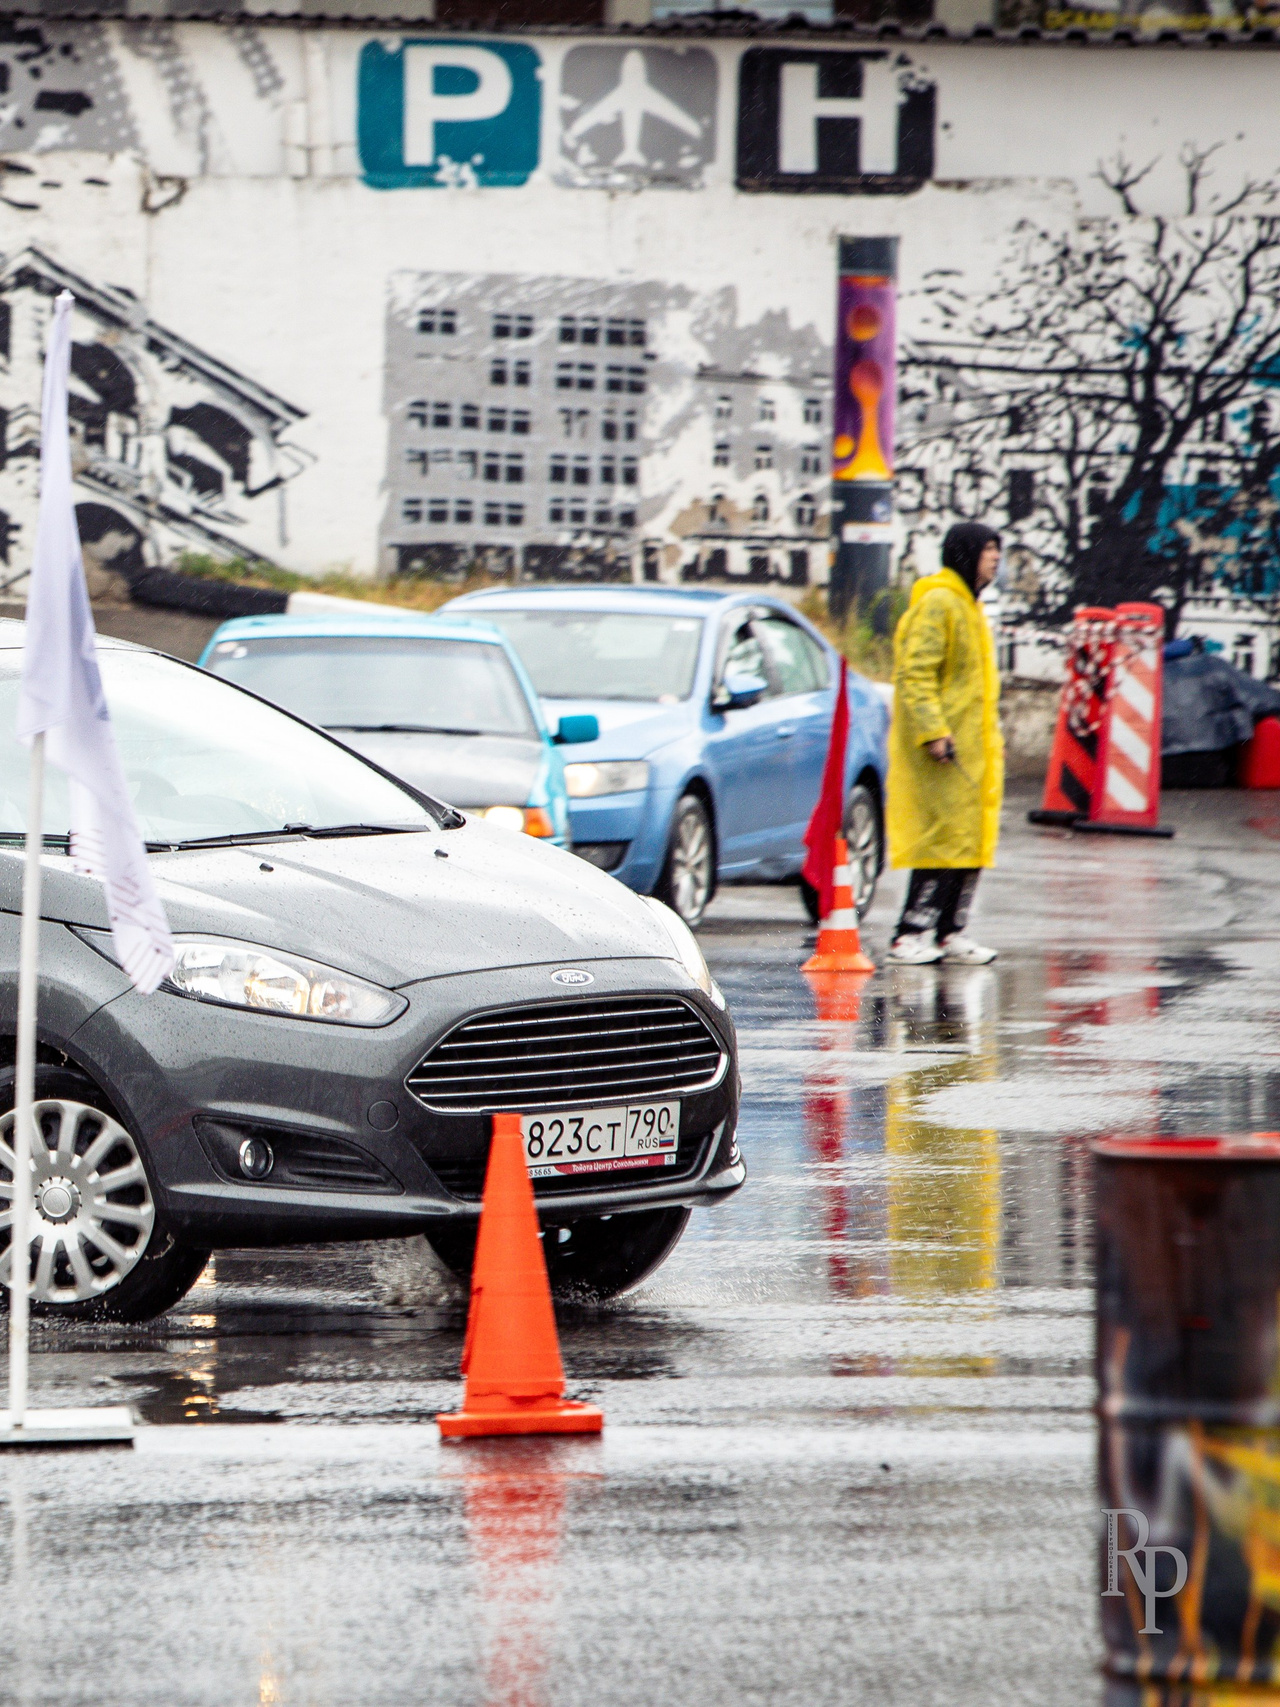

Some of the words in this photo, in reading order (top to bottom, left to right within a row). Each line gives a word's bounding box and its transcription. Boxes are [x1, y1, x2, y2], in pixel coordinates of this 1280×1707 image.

[403, 44, 513, 167] P
[778, 61, 900, 175] H
[520, 1116, 622, 1158] 823СТ
[629, 1106, 671, 1139] 790
[637, 1137, 659, 1150] RUS
[572, 1162, 593, 1172] Тойота
[593, 1161, 613, 1172] Центр
[613, 1159, 649, 1169] Сокольники
